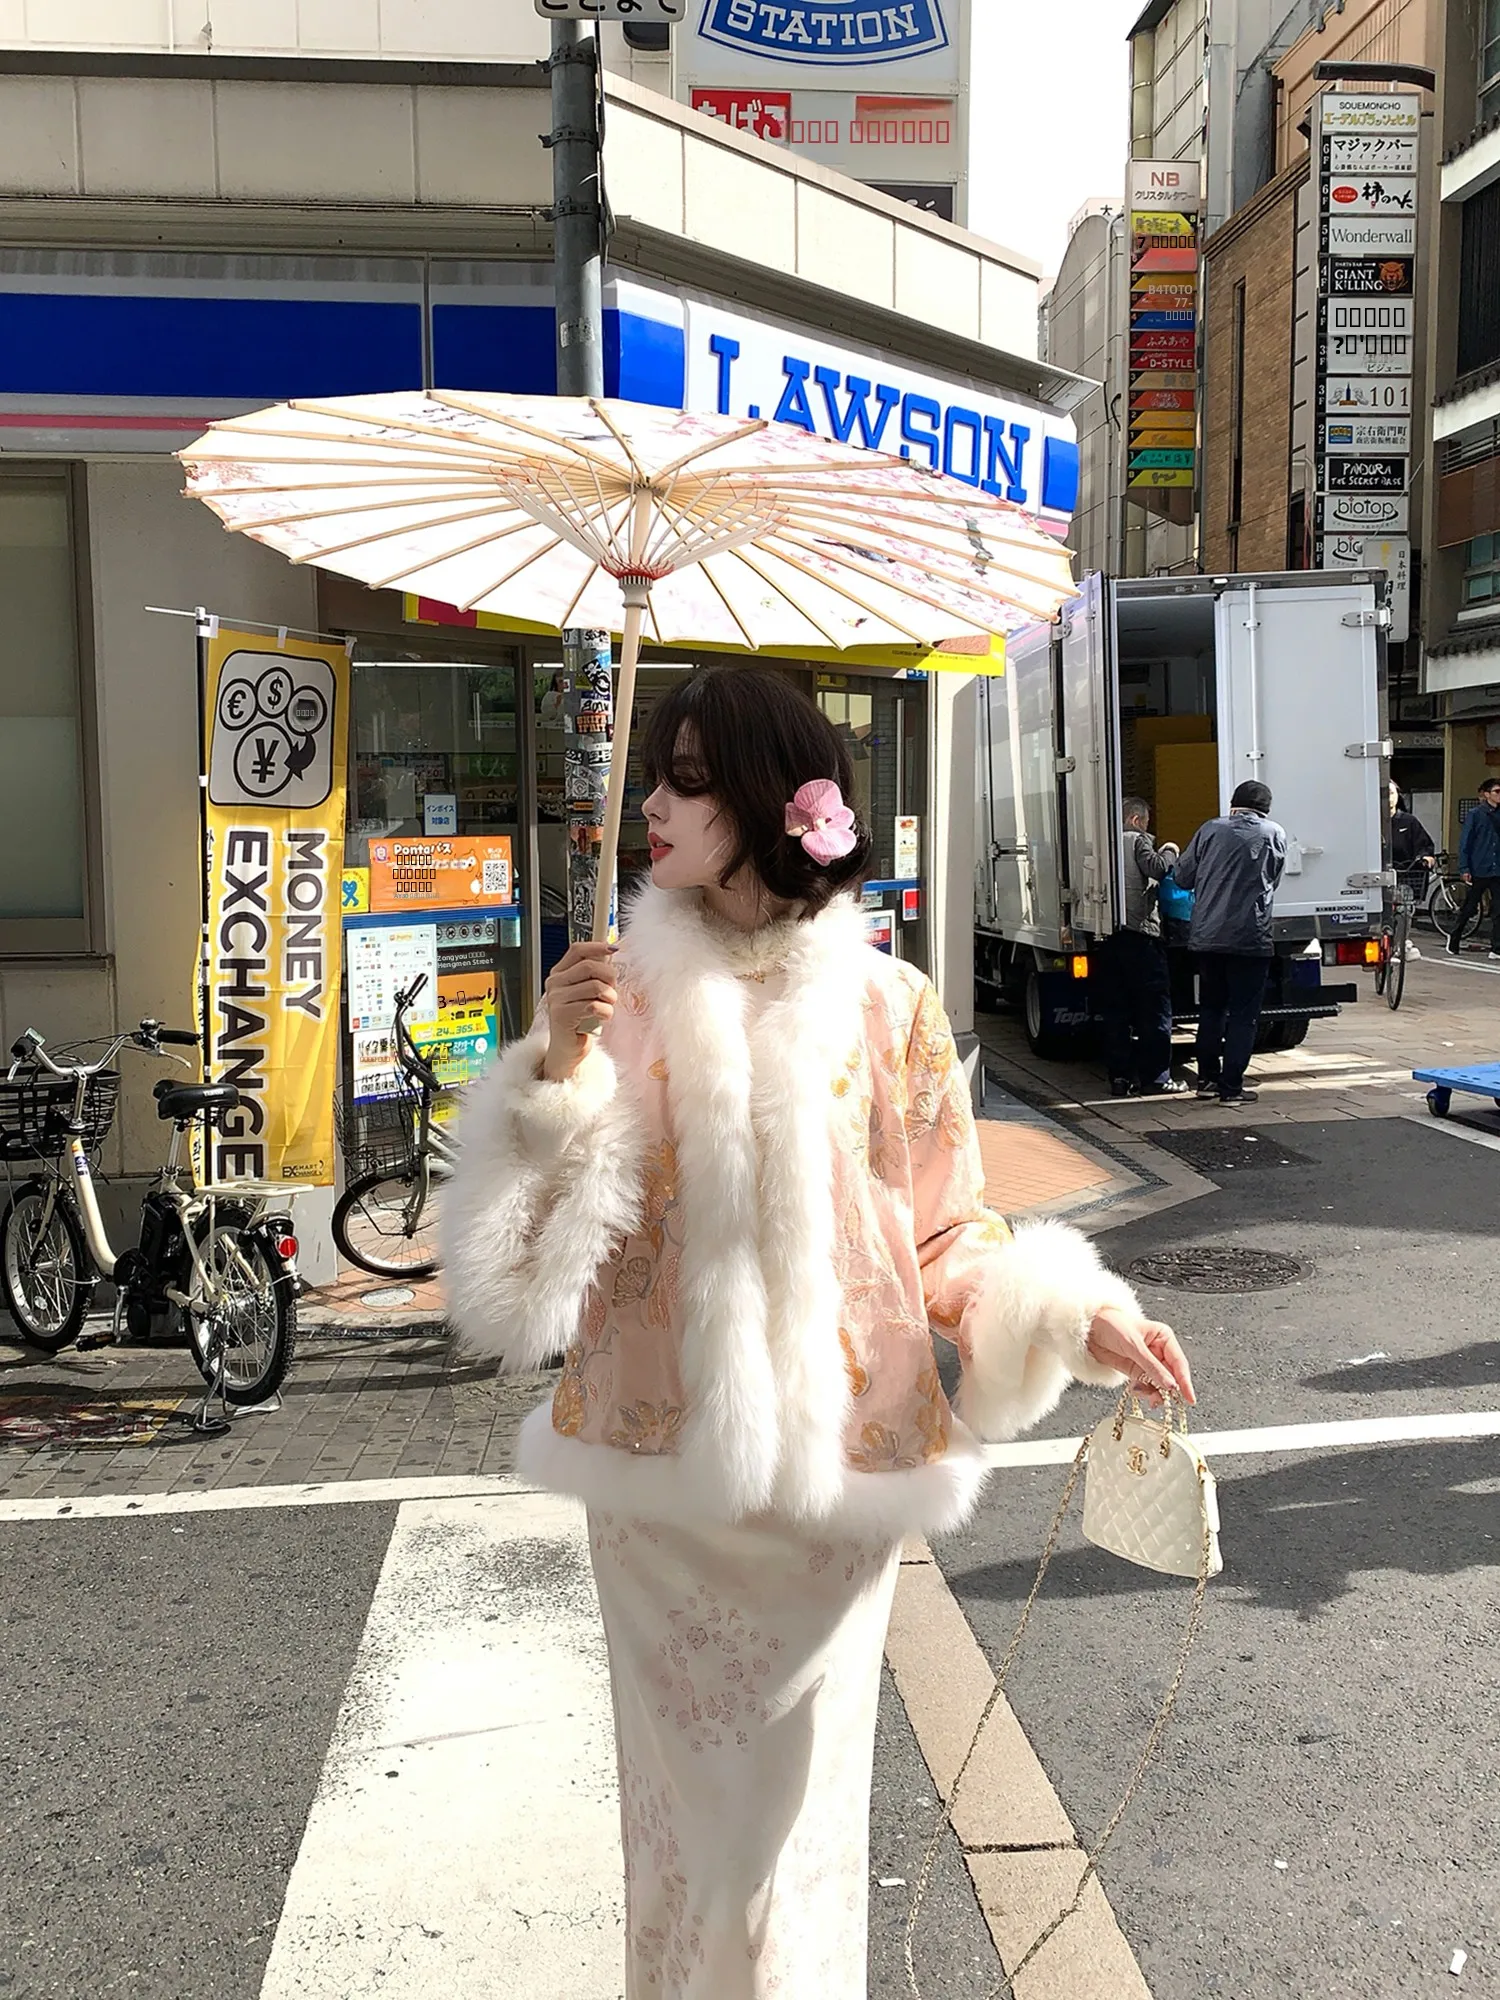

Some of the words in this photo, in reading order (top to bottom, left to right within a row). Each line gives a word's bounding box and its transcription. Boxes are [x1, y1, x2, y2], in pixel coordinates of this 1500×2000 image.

[727, 0, 920, 46] STATION
[1339, 101, 1401, 110] SOUEMONCHO
[1334, 138, 1413, 152] マジックバー
[1151, 172, 1180, 187] NB
[1134, 190, 1195, 201] クリスタルタワー
[1331, 228, 1413, 244] Wonderwall
[1334, 269, 1375, 280] GIANT
[1335, 281, 1383, 291] KILLING
[1149, 358, 1193, 368] D-STYLE
[1369, 386, 1409, 407] 101
[710, 333, 1031, 502] LAWSON
[1338, 498, 1394, 518] biotop
[285, 832, 326, 1019] MONEY
[216, 830, 270, 1181] EXCHANGE
